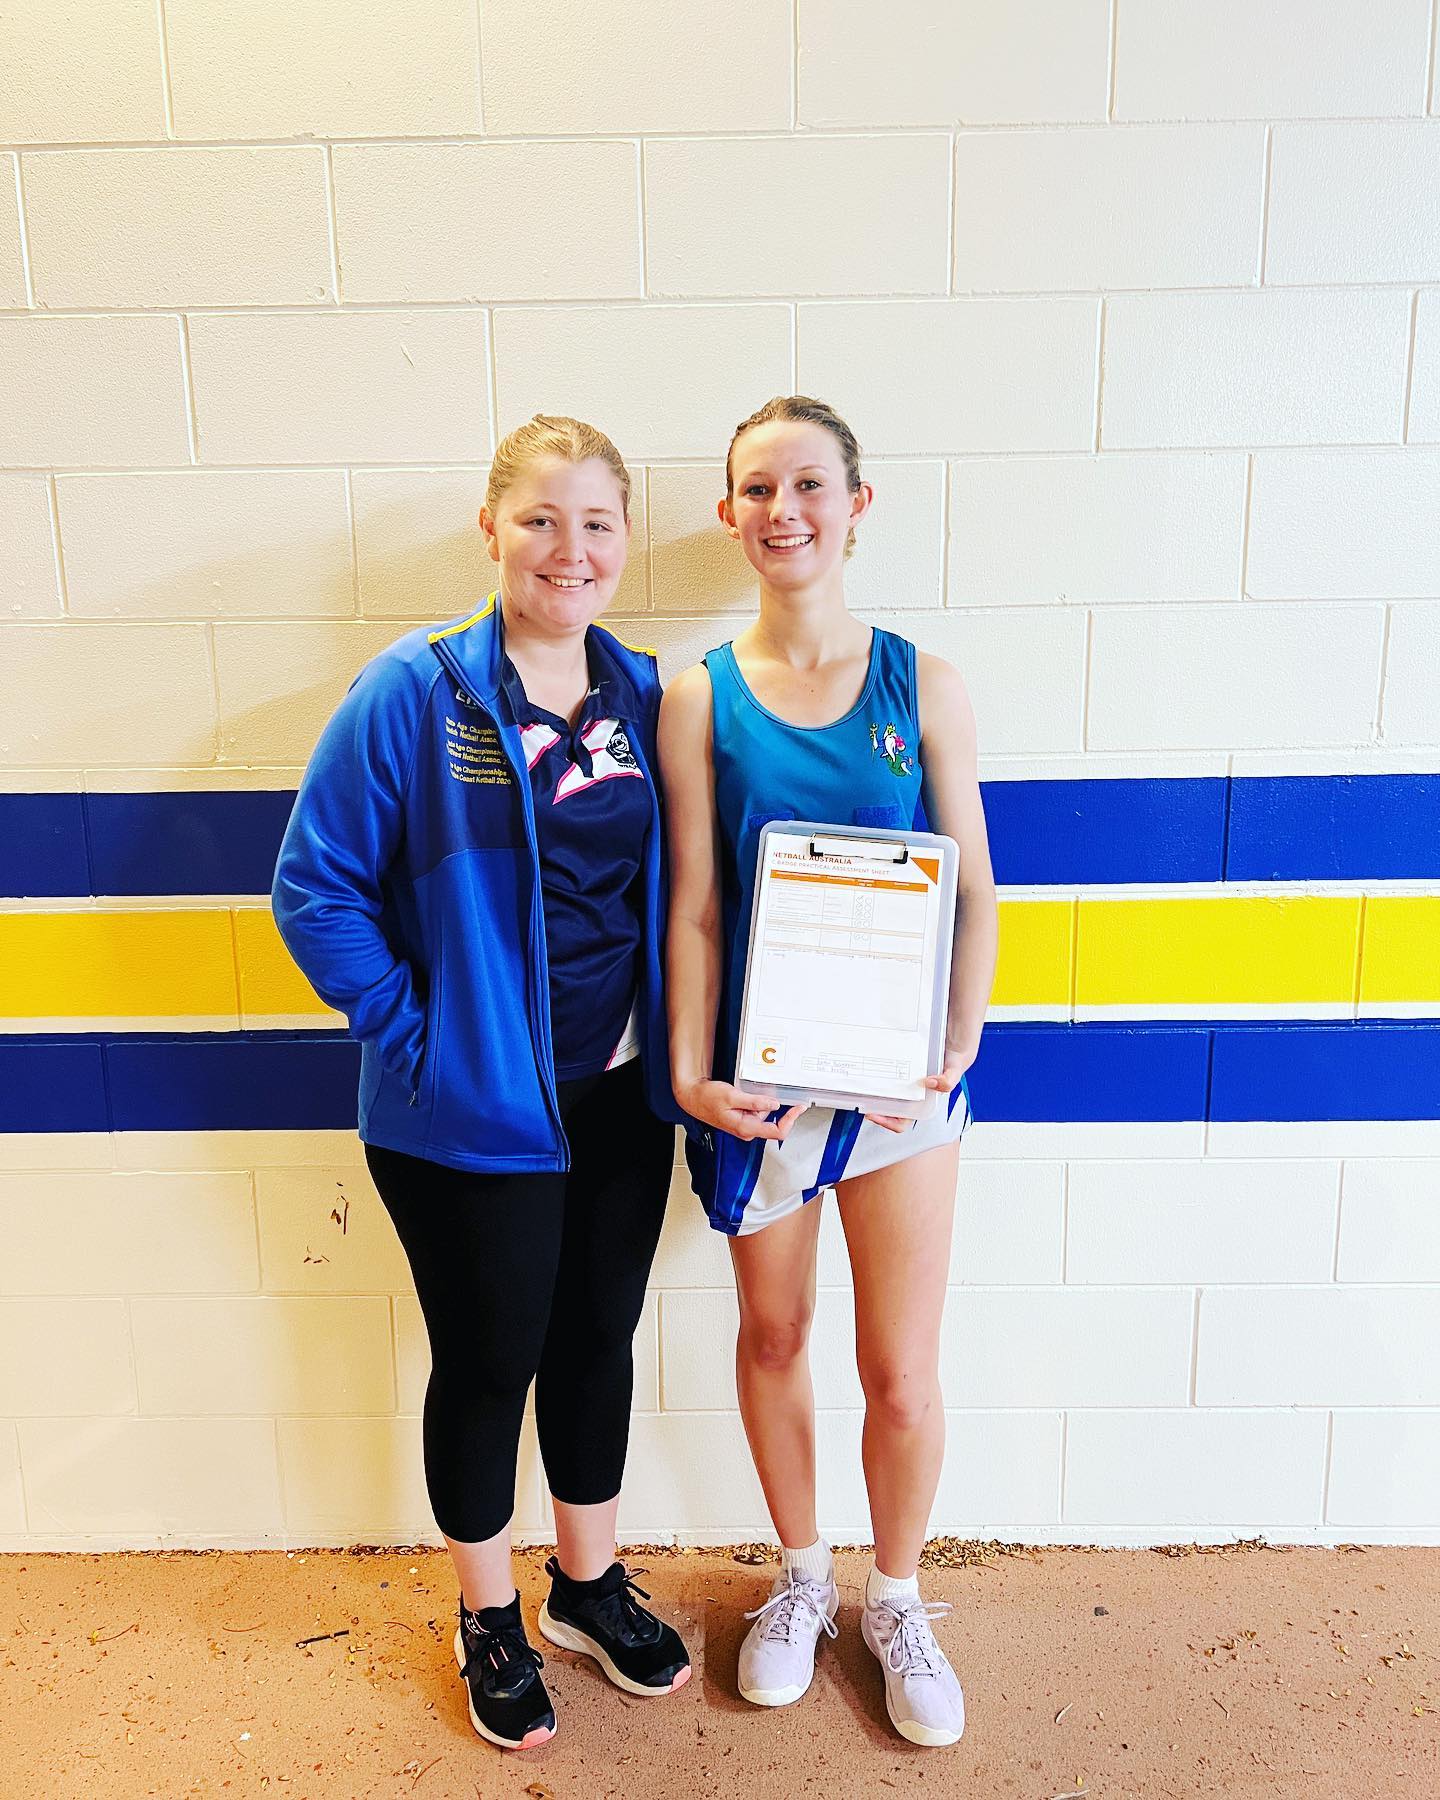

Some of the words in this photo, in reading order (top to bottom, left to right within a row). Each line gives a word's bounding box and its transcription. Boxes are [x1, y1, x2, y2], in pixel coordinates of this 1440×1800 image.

[469, 726, 497, 735] Champion
[462, 766, 507, 776] Championships
[773, 852, 807, 861] NETBALL
[809, 855, 852, 865] AUSTRALIA
[799, 862, 831, 870] PRACTICAL
[762, 1047, 777, 1064] C
